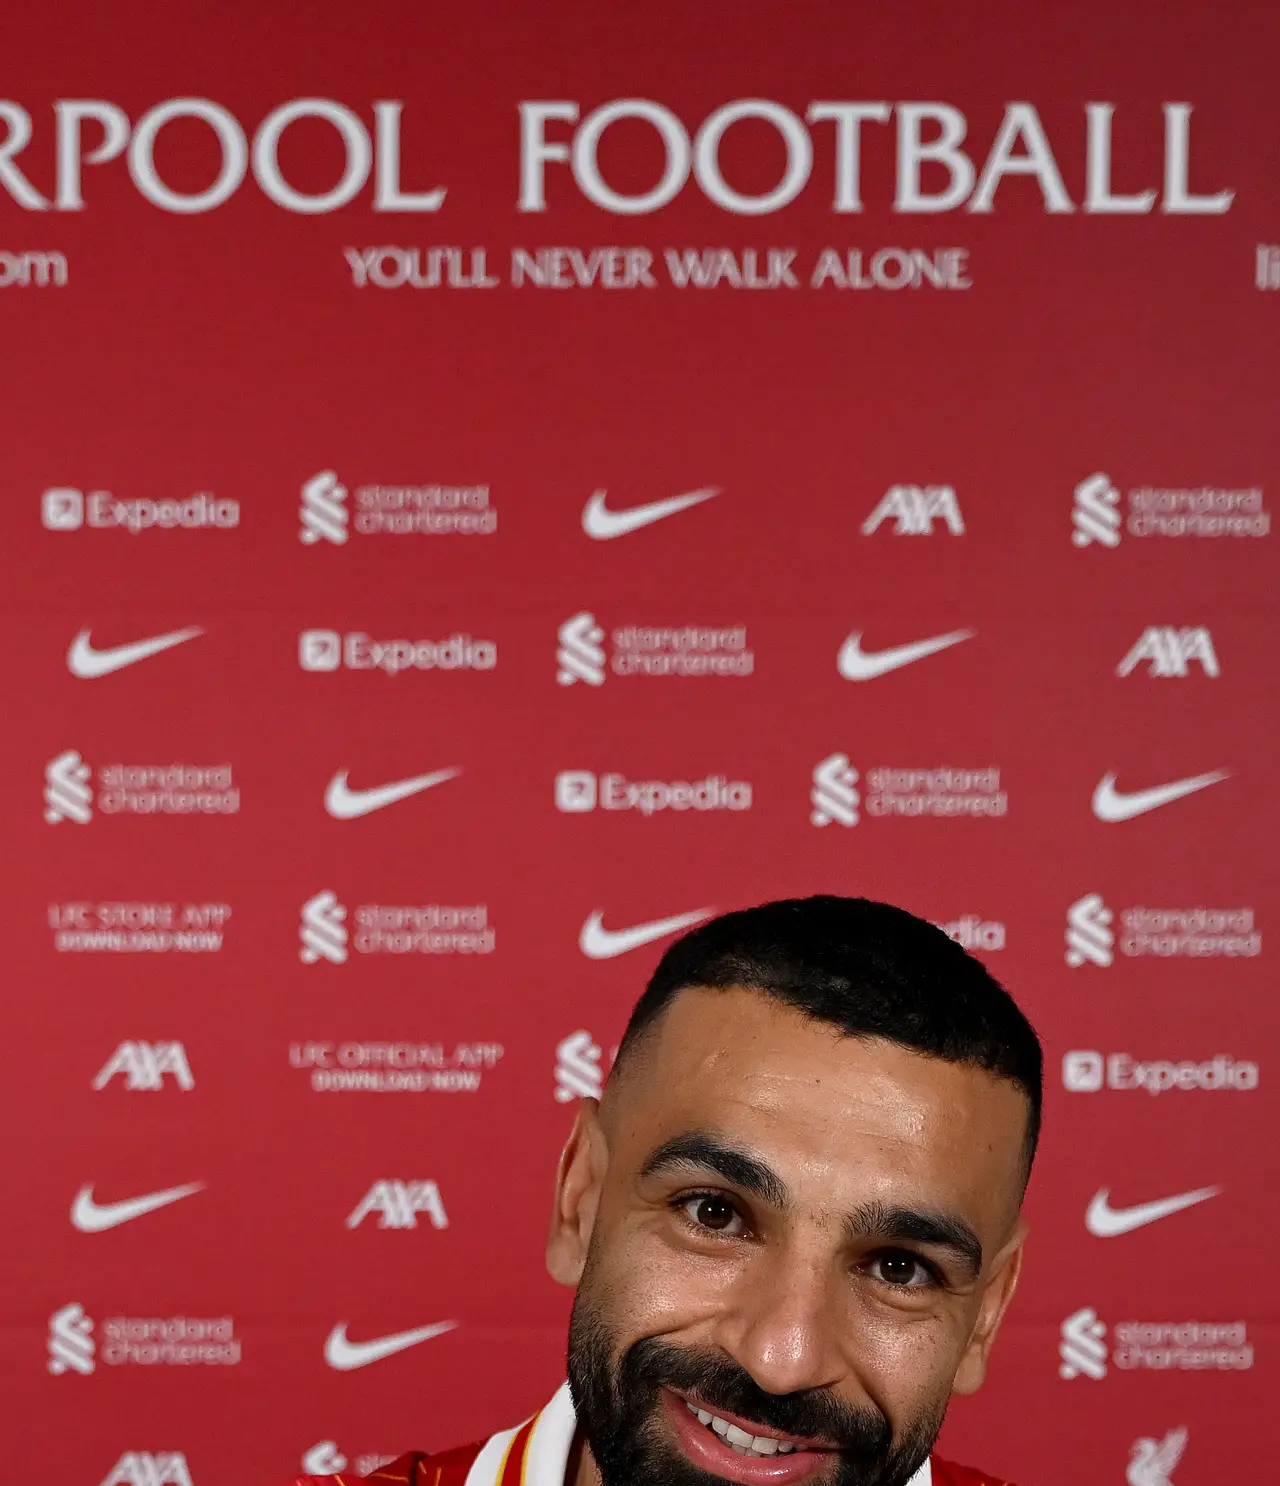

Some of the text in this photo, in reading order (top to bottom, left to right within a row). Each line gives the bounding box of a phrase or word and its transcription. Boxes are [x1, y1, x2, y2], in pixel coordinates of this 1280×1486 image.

[517, 98, 1235, 216] FOOTBALL
[513, 246, 656, 290] NEVER
[664, 246, 799, 290] WALK
[811, 247, 972, 290] ALONE
[88, 491, 241, 531] Expedia
[861, 484, 965, 536] AXA
[345, 633, 498, 673] Expedia
[1116, 626, 1220, 678] AXA
[601, 774, 753, 813] Expedia
[92, 1040, 194, 1090] AXA
[1109, 1053, 1260, 1095] Expedia
[346, 1179, 448, 1229] AXA
